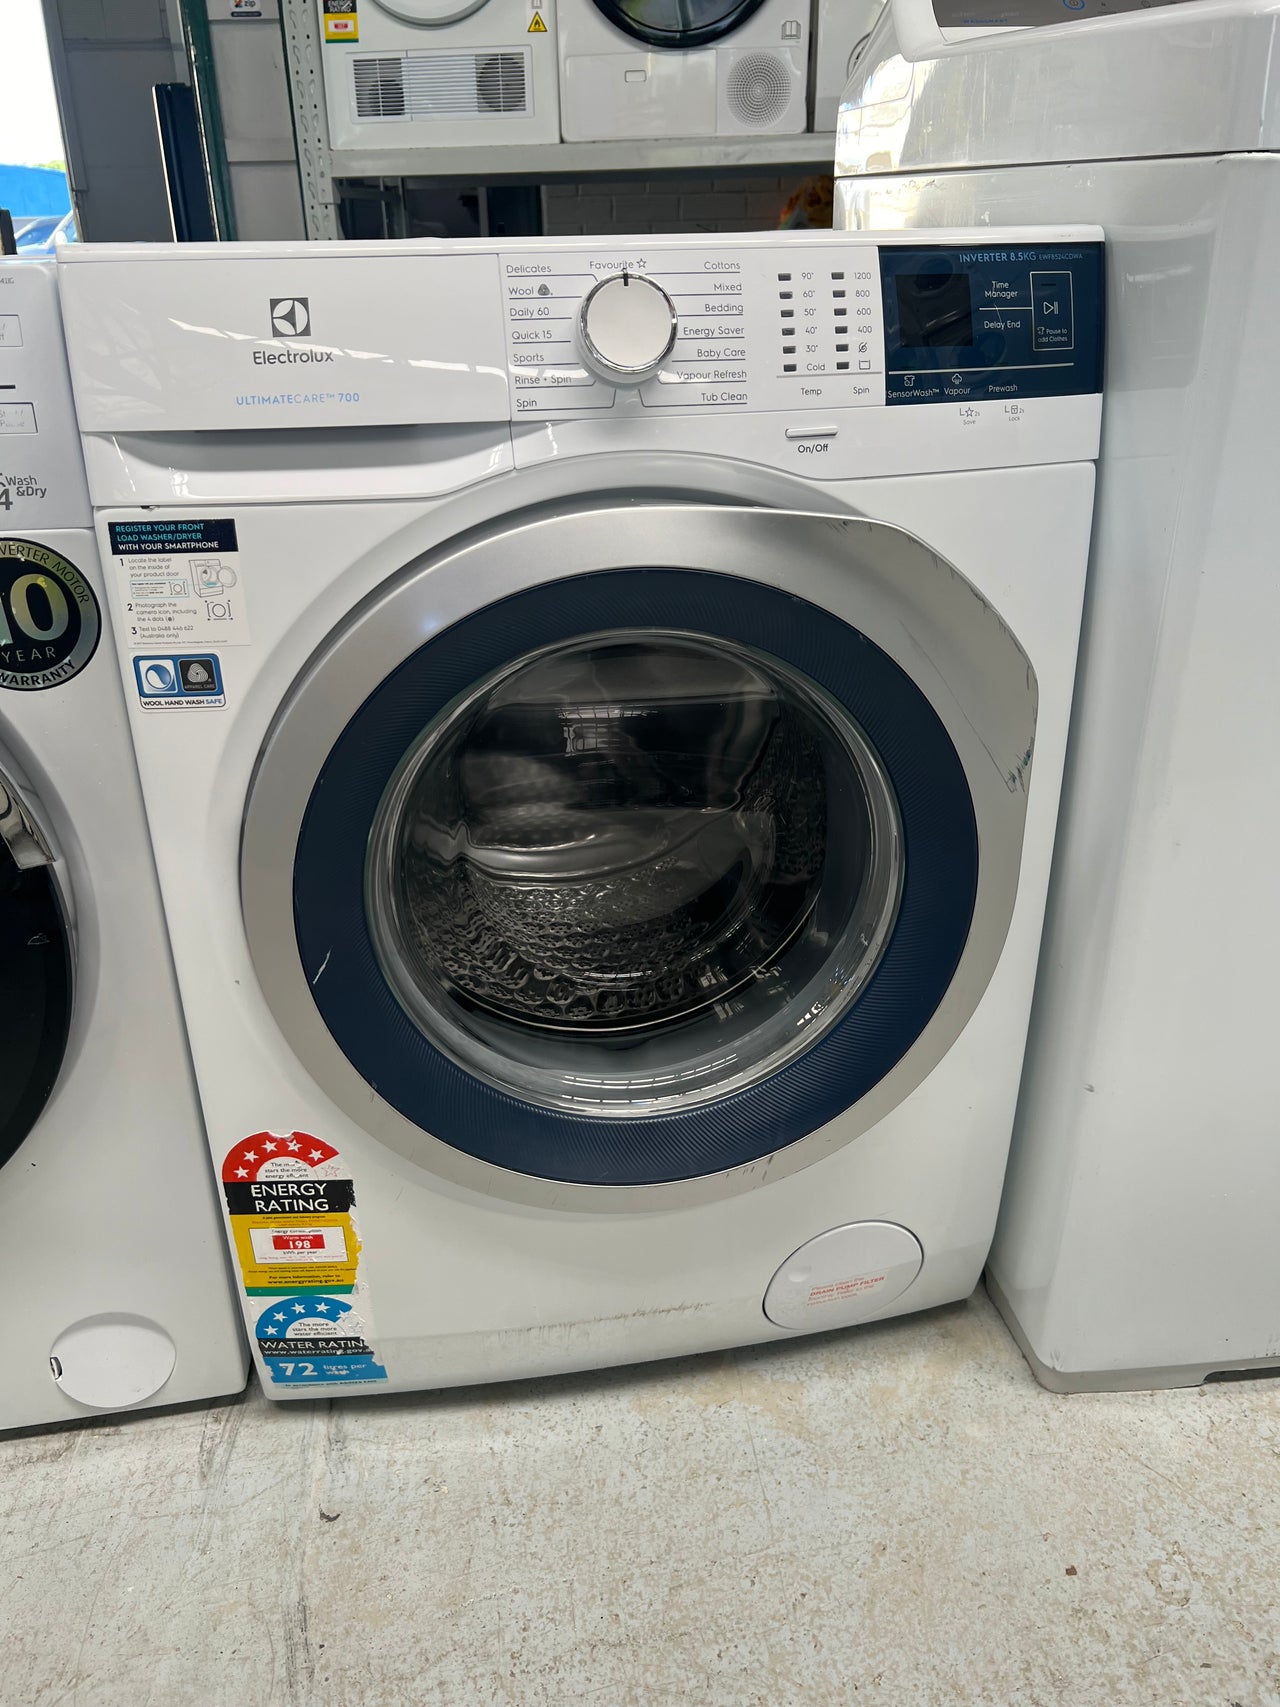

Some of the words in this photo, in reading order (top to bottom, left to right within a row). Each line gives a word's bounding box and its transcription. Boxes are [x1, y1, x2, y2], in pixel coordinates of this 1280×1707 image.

[959, 252, 1008, 263] INVERTER
[1010, 251, 1037, 262] 8.5KG
[506, 264, 552, 273] Delicates
[589, 260, 634, 269] Favourite
[704, 261, 741, 270] Cottons
[854, 272, 872, 280] 1200
[714, 283, 742, 292] Mixed
[992, 281, 1009, 289] Time
[508, 287, 534, 296] Wool
[984, 290, 1018, 299] Manager
[510, 308, 535, 318] Daily
[537, 307, 550, 316] 60
[704, 303, 744, 314] Bedding
[856, 308, 872, 316] 600
[857, 326, 873, 334] 400
[984, 320, 1005, 330] Delay
[1007, 320, 1021, 329] End
[512, 330, 540, 340] Quick
[543, 330, 553, 339] 15
[683, 327, 715, 338] Energy
[719, 326, 745, 335] Saver
[252, 349, 334, 365] Electrolux
[513, 353, 545, 363] Sports
[697, 349, 721, 359] Baby
[723, 348, 746, 357] Care
[806, 363, 826, 371] Cold
[514, 375, 541, 385] Rinse
[551, 375, 572, 385] Spin
[677, 371, 711, 381] Vapour
[714, 370, 747, 379] Refresh
[801, 387, 822, 396] Temp
[853, 386, 870, 395] Spin
[944, 387, 971, 396] Vapour
[988, 384, 1018, 393] Prewash
[338, 392, 360, 403] 700
[701, 393, 718, 402] Tub
[721, 391, 748, 401] Clean
[516, 399, 538, 409] Spin
[798, 443, 829, 454] On/Off
[5, 475, 38, 486] Wash
[16, 486, 47, 499] &Dry
[115, 525, 152, 533] REGISTER
[154, 524, 176, 532] YOUR
[178, 523, 205, 531] FRONT
[117, 534, 139, 542] LOAD
[140, 533, 202, 541] WASHER/DRYER
[118, 543, 139, 551] WITH
[164, 541, 220, 550] SMARTPHONE
[119, 558, 124, 567] 1
[52, 561, 90, 604] MOTOR
[127, 603, 133, 611] 2
[131, 627, 138, 635] 3
[1, 646, 56, 664] YEAR
[143, 699, 164, 707] WOOL
[250, 1183, 327, 1198] ENERGY
[255, 1198, 330, 1212] RATING
[289, 1240, 311, 1249] 198
[810, 1288, 835, 1297] DRAIN
[836, 1282, 859, 1292] PUMP
[859, 1276, 885, 1286] FILTER
[261, 1341, 315, 1349] WATER
[319, 1340, 365, 1349] RATIN
[279, 1362, 318, 1376] 72
